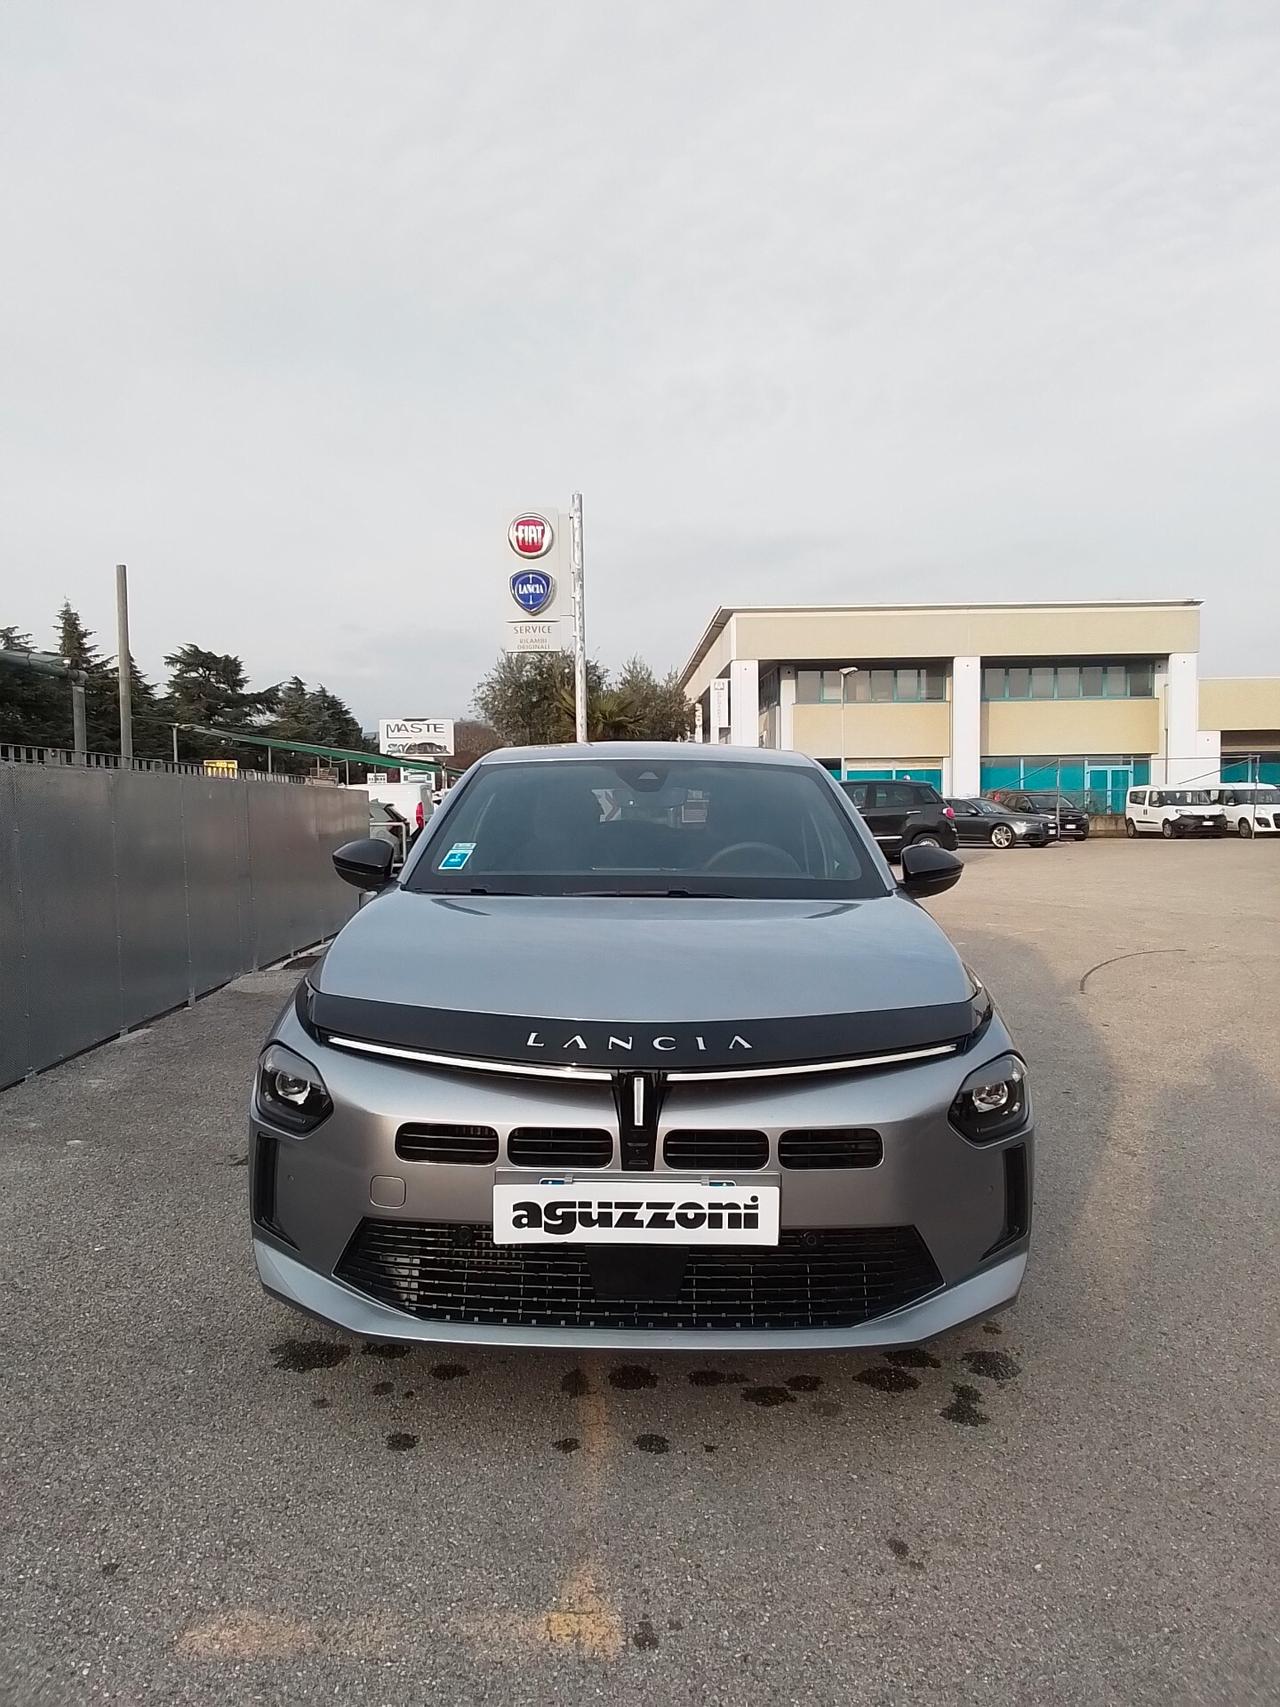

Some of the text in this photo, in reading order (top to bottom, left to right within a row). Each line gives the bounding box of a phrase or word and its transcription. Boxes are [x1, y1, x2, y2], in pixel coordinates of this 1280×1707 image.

[517, 525, 543, 545] FIAT
[519, 584, 544, 594] LANCIA
[513, 625, 552, 634] SERVICE
[526, 1032, 753, 1051] LANCIA
[512, 1195, 759, 1236] aguzzoni
